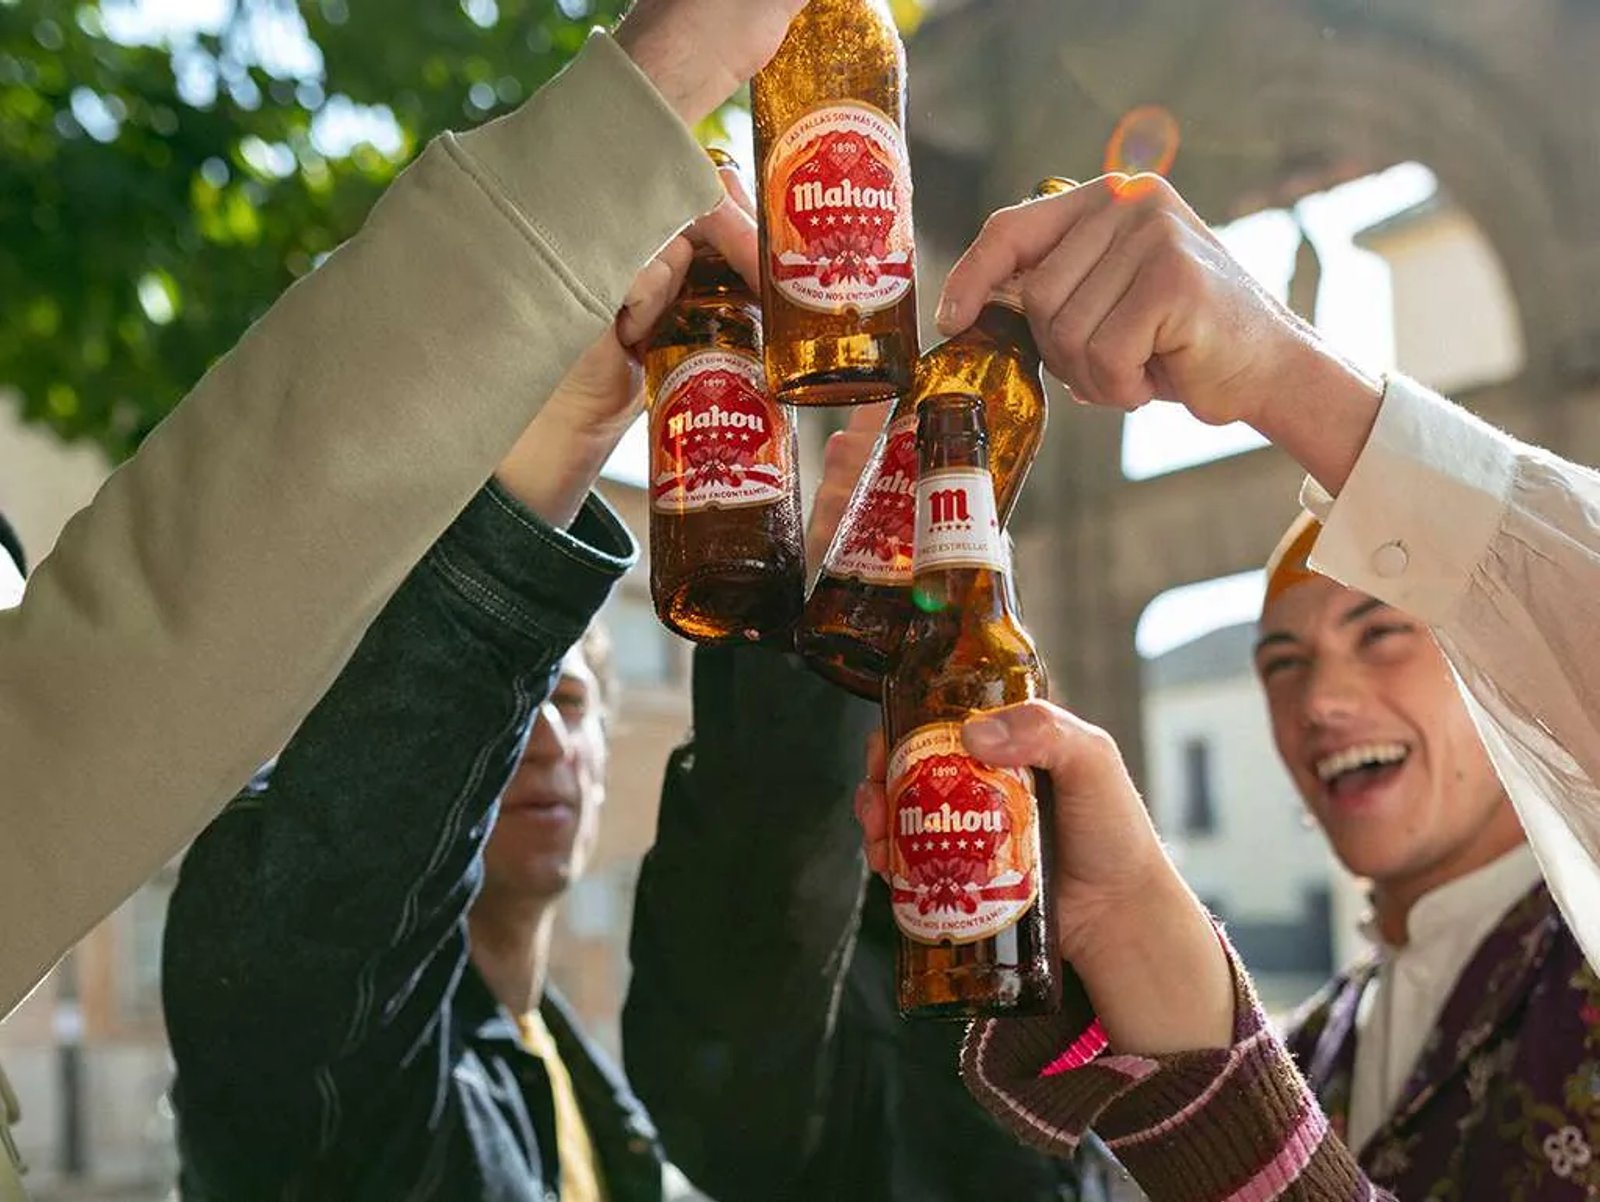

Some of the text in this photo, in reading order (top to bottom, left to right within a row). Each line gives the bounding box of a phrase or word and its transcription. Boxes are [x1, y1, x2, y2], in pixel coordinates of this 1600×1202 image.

[784, 129, 801, 145] LAS
[799, 113, 832, 132] FALLAS
[833, 112, 853, 122] SON
[831, 142, 857, 153] 1890
[793, 178, 897, 212] Mahou
[791, 280, 824, 299] CUANDO
[826, 292, 843, 301] NOS
[668, 405, 765, 439] Mahou
[931, 766, 958, 777] 1890
[899, 802, 1004, 836] Mahou
